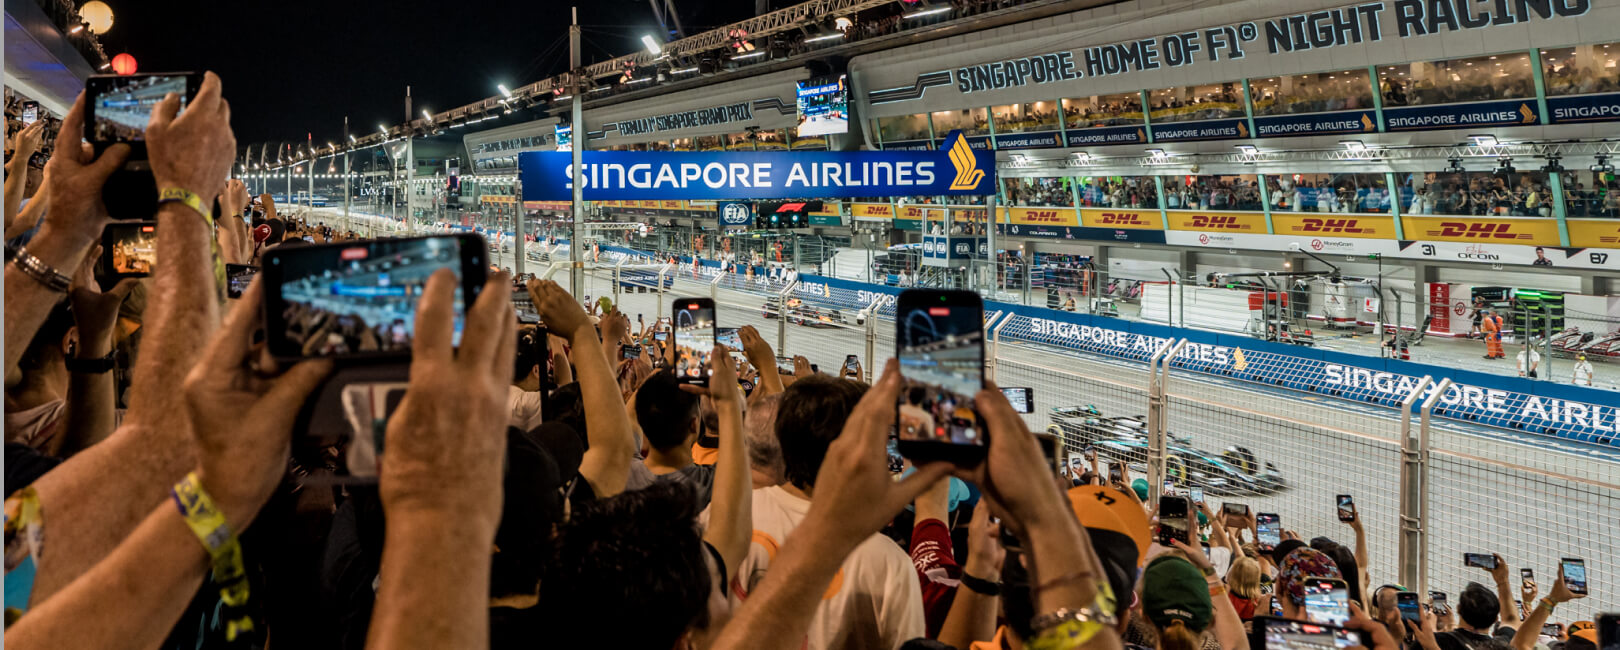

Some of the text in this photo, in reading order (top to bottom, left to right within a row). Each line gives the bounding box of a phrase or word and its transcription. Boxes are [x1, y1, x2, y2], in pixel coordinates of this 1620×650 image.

[956, 51, 1084, 94] SINGAPORE.
[1085, 38, 1161, 77] HOME
[1162, 31, 1200, 67] OF
[1265, 1, 1384, 54] NIGHT
[619, 118, 649, 136] FORMULA
[656, 111, 698, 132] SINGAPORE
[698, 106, 728, 126] GRAND
[726, 101, 753, 122] PRIX
[1388, 110, 1517, 127] SINGAPORE AIRLINES
[1154, 127, 1237, 139] SINGAPORE AIRLINES
[1258, 119, 1360, 134] SINGAPORE AIRLINES
[1069, 133, 1137, 144] SINGAPORE AIRLINES
[565, 161, 936, 189] SINGAPORE AIRLINES
[725, 206, 747, 220] FIA
[866, 206, 890, 215] DHL
[1026, 211, 1060, 222] DHL
[1101, 212, 1142, 225] DHL
[1191, 215, 1241, 229] DHL
[1302, 218, 1363, 234] DHL
[1439, 222, 1517, 239] DHL
[1421, 244, 1436, 256] 31
[1457, 252, 1499, 260] OCON
[1590, 253, 1608, 265] 87
[1030, 317, 1127, 348] SINGAPORE
